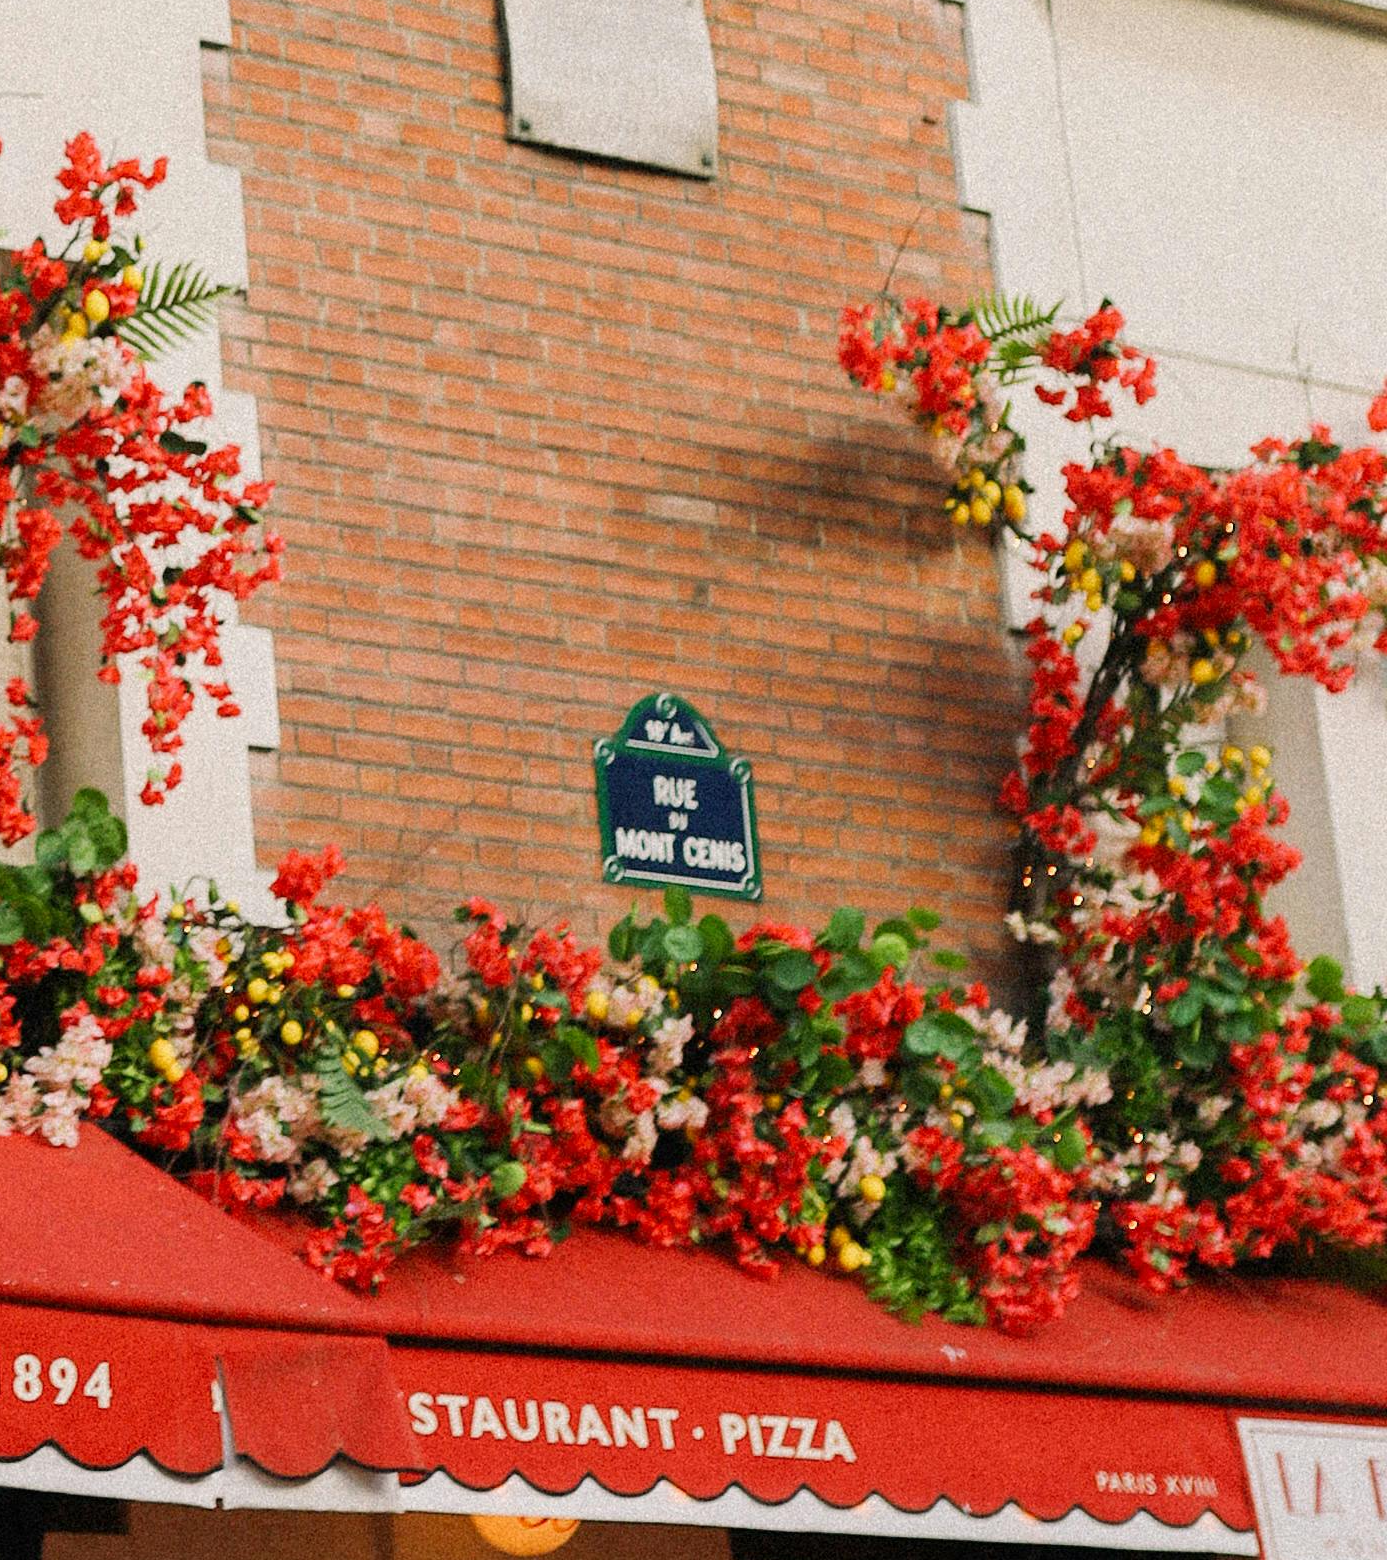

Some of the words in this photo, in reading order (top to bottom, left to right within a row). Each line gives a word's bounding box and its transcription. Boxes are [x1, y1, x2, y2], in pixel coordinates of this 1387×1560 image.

[653, 774, 699, 810] RUE
[668, 811, 689, 831] DU
[614, 826, 676, 865] MONT
[682, 835, 747, 874] CENIS
[718, 1412, 857, 1464] PIZZA
[1095, 1469, 1158, 1496] PARIS
